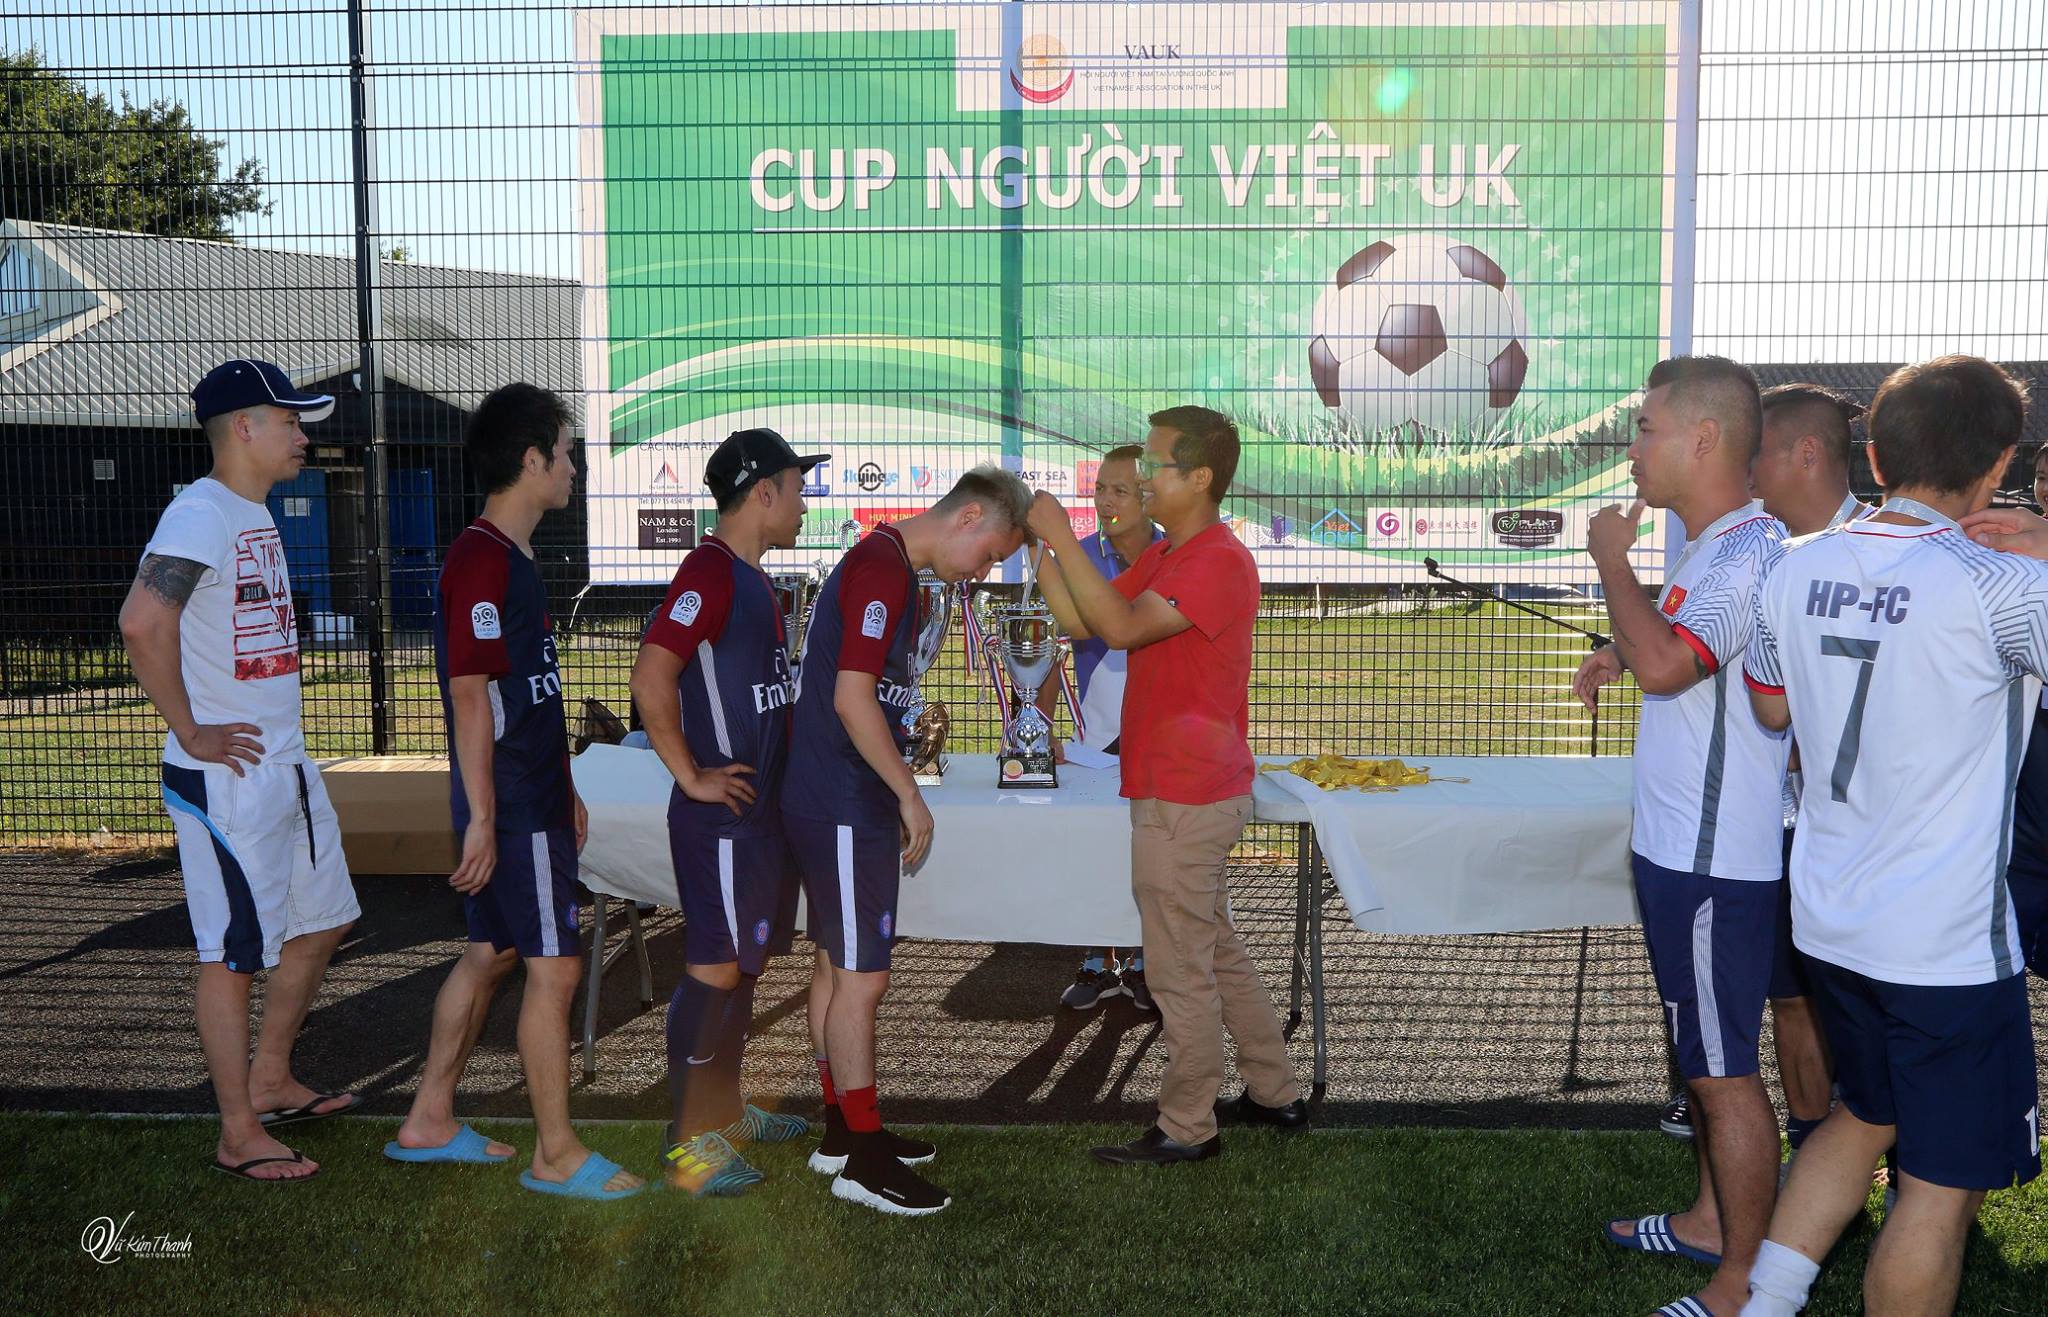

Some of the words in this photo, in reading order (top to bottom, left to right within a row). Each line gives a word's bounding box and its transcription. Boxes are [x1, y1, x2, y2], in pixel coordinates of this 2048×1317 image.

[1124, 44, 1180, 60] VAUK
[750, 147, 897, 213] CUP
[926, 124, 1184, 213] NGƯỜI
[1210, 122, 1391, 224] VIỆT
[1418, 144, 1523, 210] UK
[1015, 471, 1041, 481] EAST
[1045, 471, 1067, 481] SEA
[640, 518, 666, 526] NAM
[669, 518, 678, 526] &
[680, 518, 695, 526] Co.
[1805, 579, 1911, 625] HP-FC
[1820, 635, 1880, 804] 7
